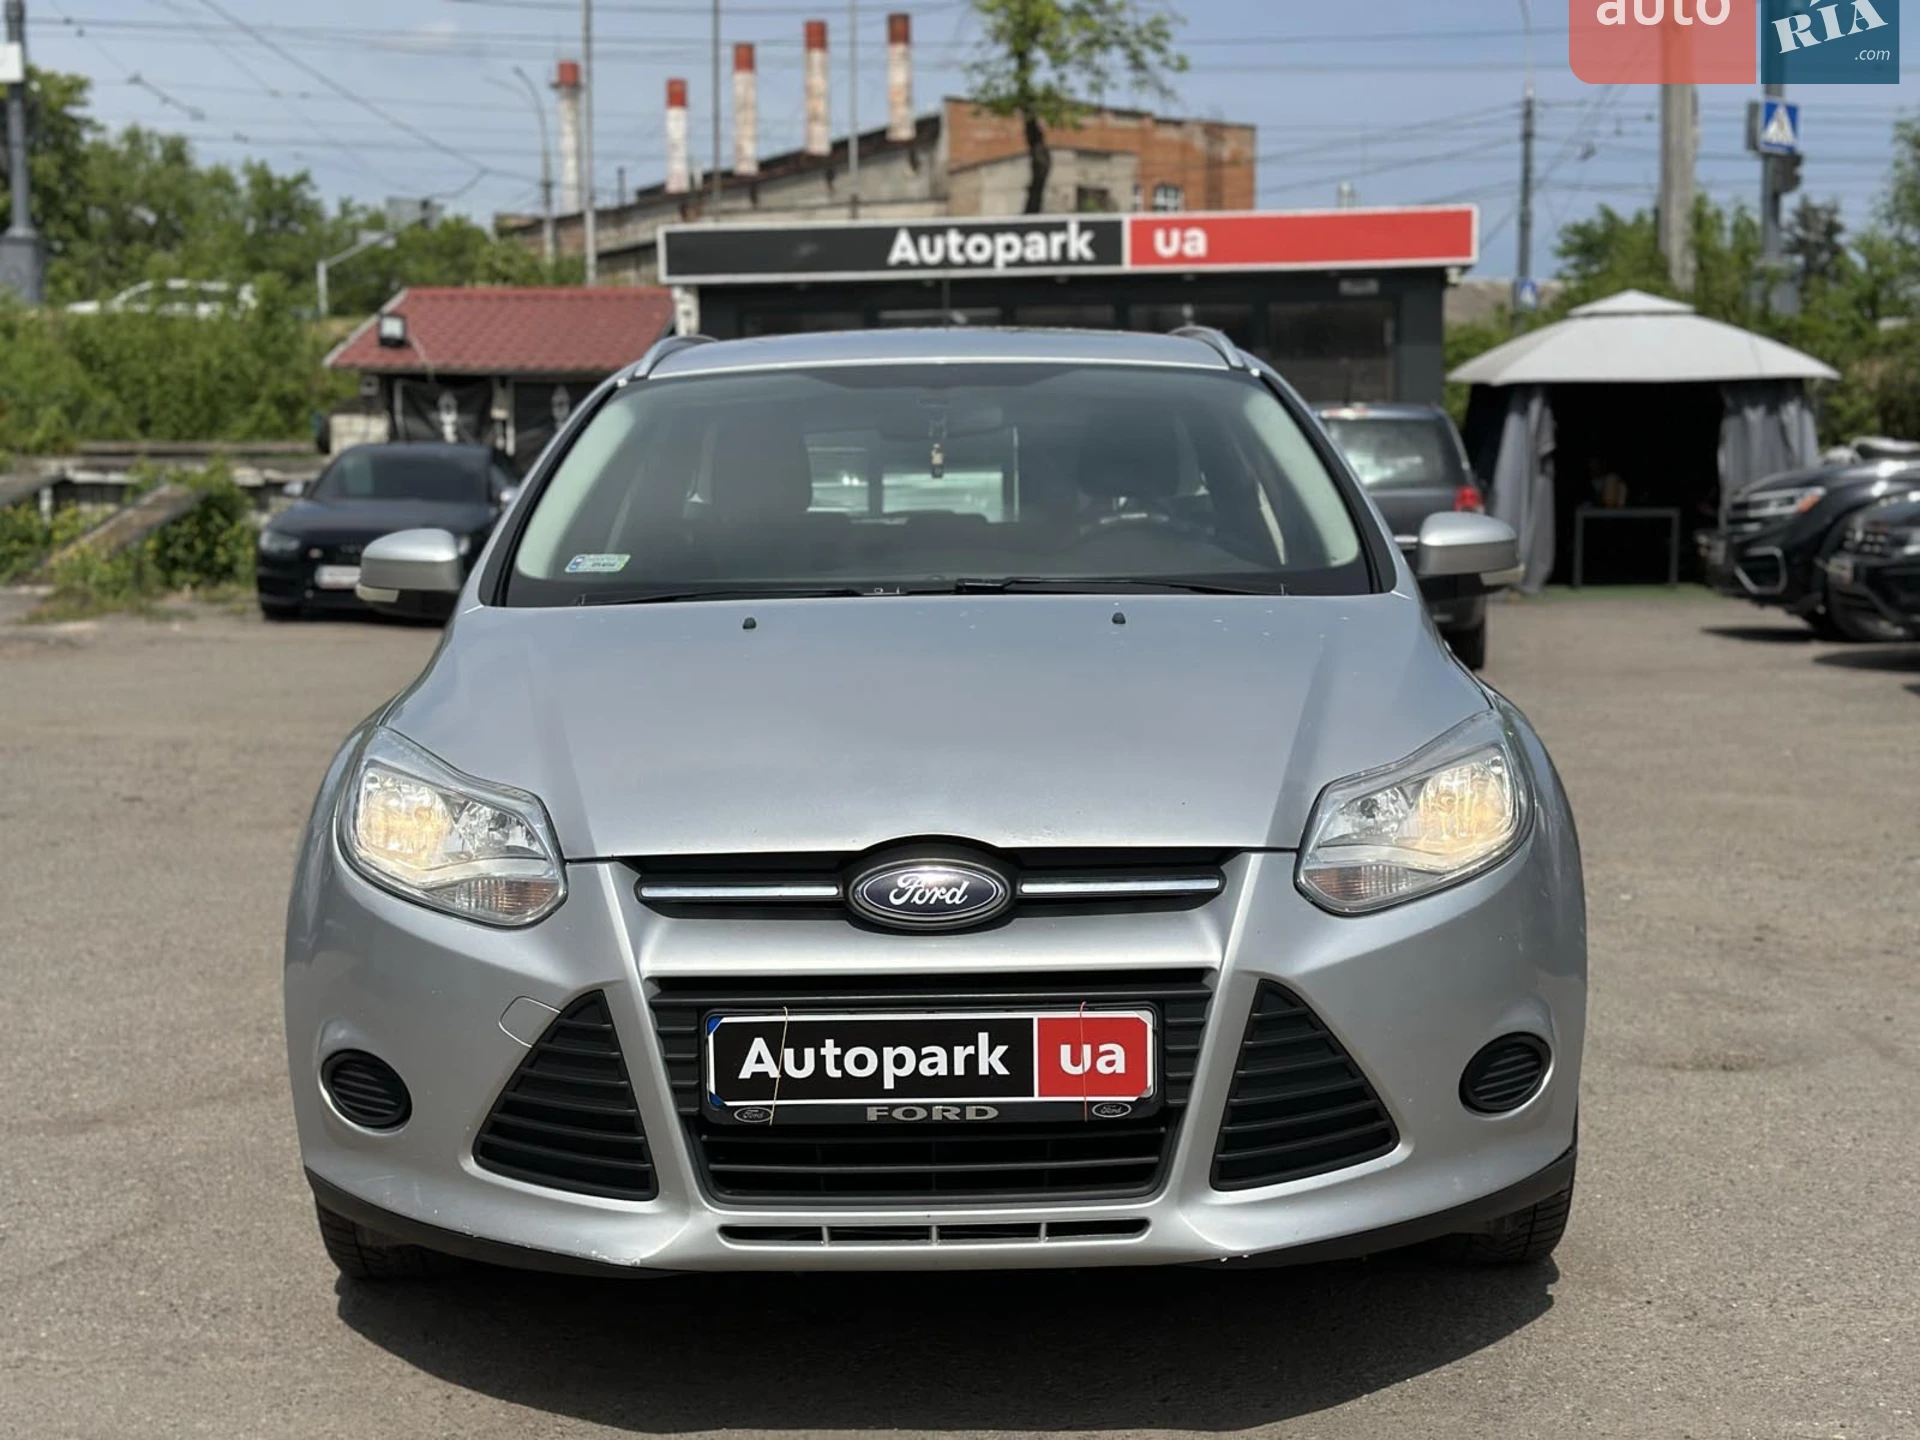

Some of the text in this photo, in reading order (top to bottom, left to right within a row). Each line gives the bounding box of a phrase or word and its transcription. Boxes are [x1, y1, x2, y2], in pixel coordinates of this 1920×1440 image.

[887, 220, 1208, 269] Autopark ua
[888, 873, 970, 905] Ford
[738, 1032, 1126, 1090] Autopark ua
[866, 1105, 999, 1121] FORD
